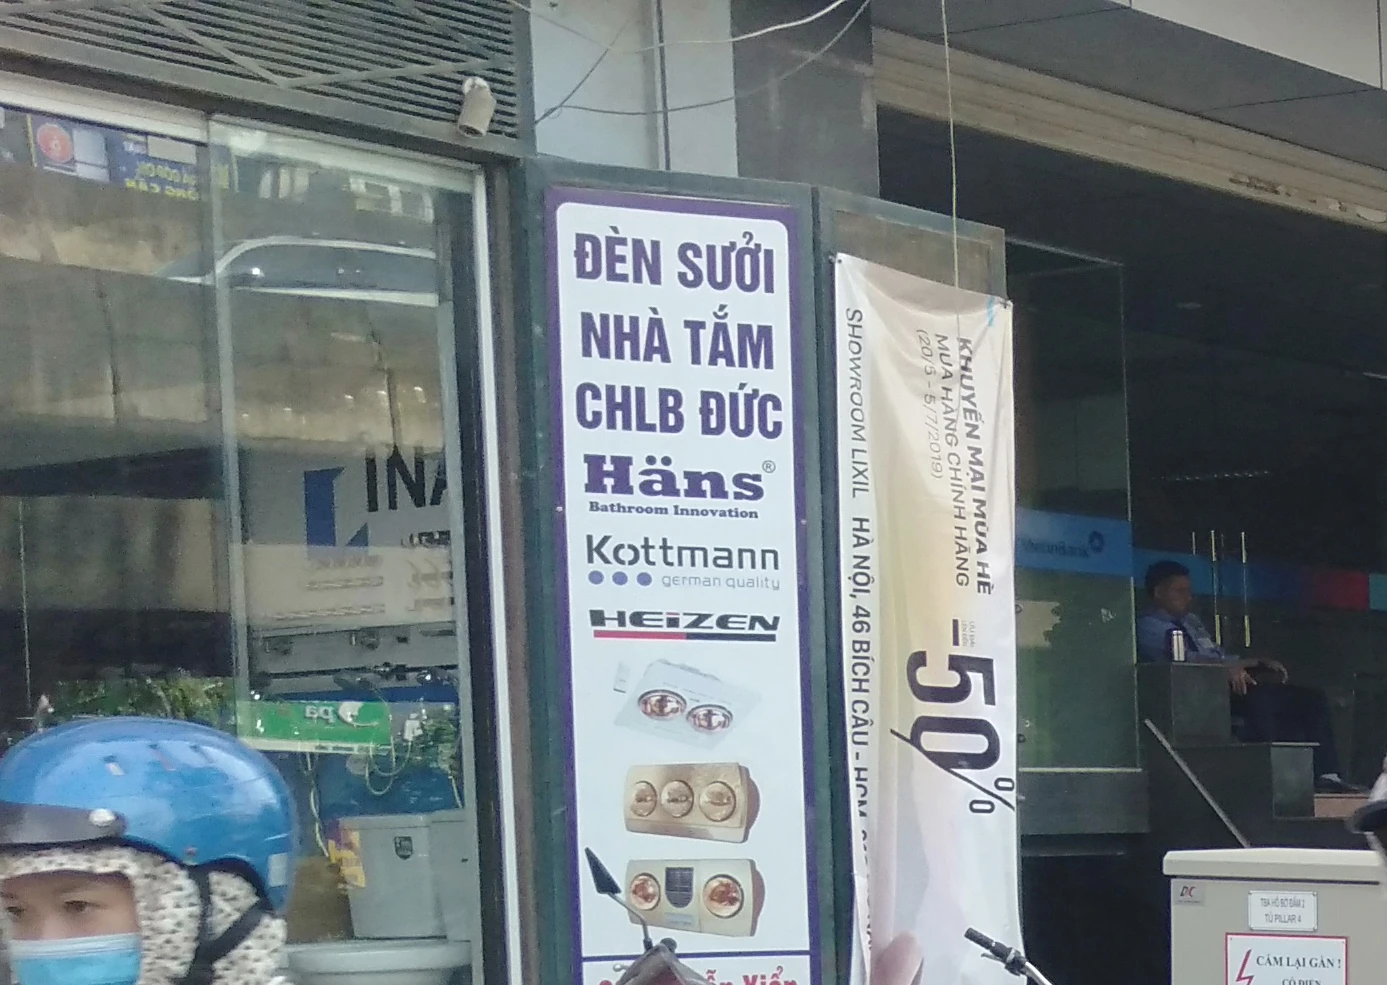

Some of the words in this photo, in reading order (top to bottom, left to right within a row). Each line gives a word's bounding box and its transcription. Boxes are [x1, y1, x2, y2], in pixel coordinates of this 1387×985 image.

[574, 226, 663, 286] ĐÈN
[677, 230, 775, 294] SƯỞI
[580, 306, 671, 364] NHÀ
[683, 305, 774, 370] TẮM
[917, 329, 937, 376] (20/5
[935, 334, 953, 380] MUA
[846, 309, 866, 441] SHOWROOM
[957, 337, 986, 440] KHUYẾN
[575, 382, 684, 435] CHLB
[699, 383, 783, 440] ĐỨC
[941, 386, 961, 447] HÀNG
[923, 394, 944, 480] 5/7/2019)
[583, 453, 764, 501] Häns
[851, 449, 870, 498] LIXIL
[947, 452, 968, 519] CHÍNH
[965, 445, 986, 492] MẠI
[588, 501, 668, 517] Bathroom
[673, 505, 759, 519] Innovation
[852, 517, 875, 549] HÀ
[972, 496, 991, 555] MÙA
[586, 535, 780, 571] Kottmann
[953, 526, 972, 587] HÃNG
[661, 574, 720, 588] german
[723, 574, 781, 591] quality
[976, 561, 994, 596] HÈ
[852, 604, 872, 634] 46
[852, 640, 873, 694] BÍCH
[852, 699, 875, 746] CÂU
[1256, 955, 1284, 968] CẤM
[1286, 957, 1306, 969] LẠI
[1309, 957, 1335, 969] GẦN
